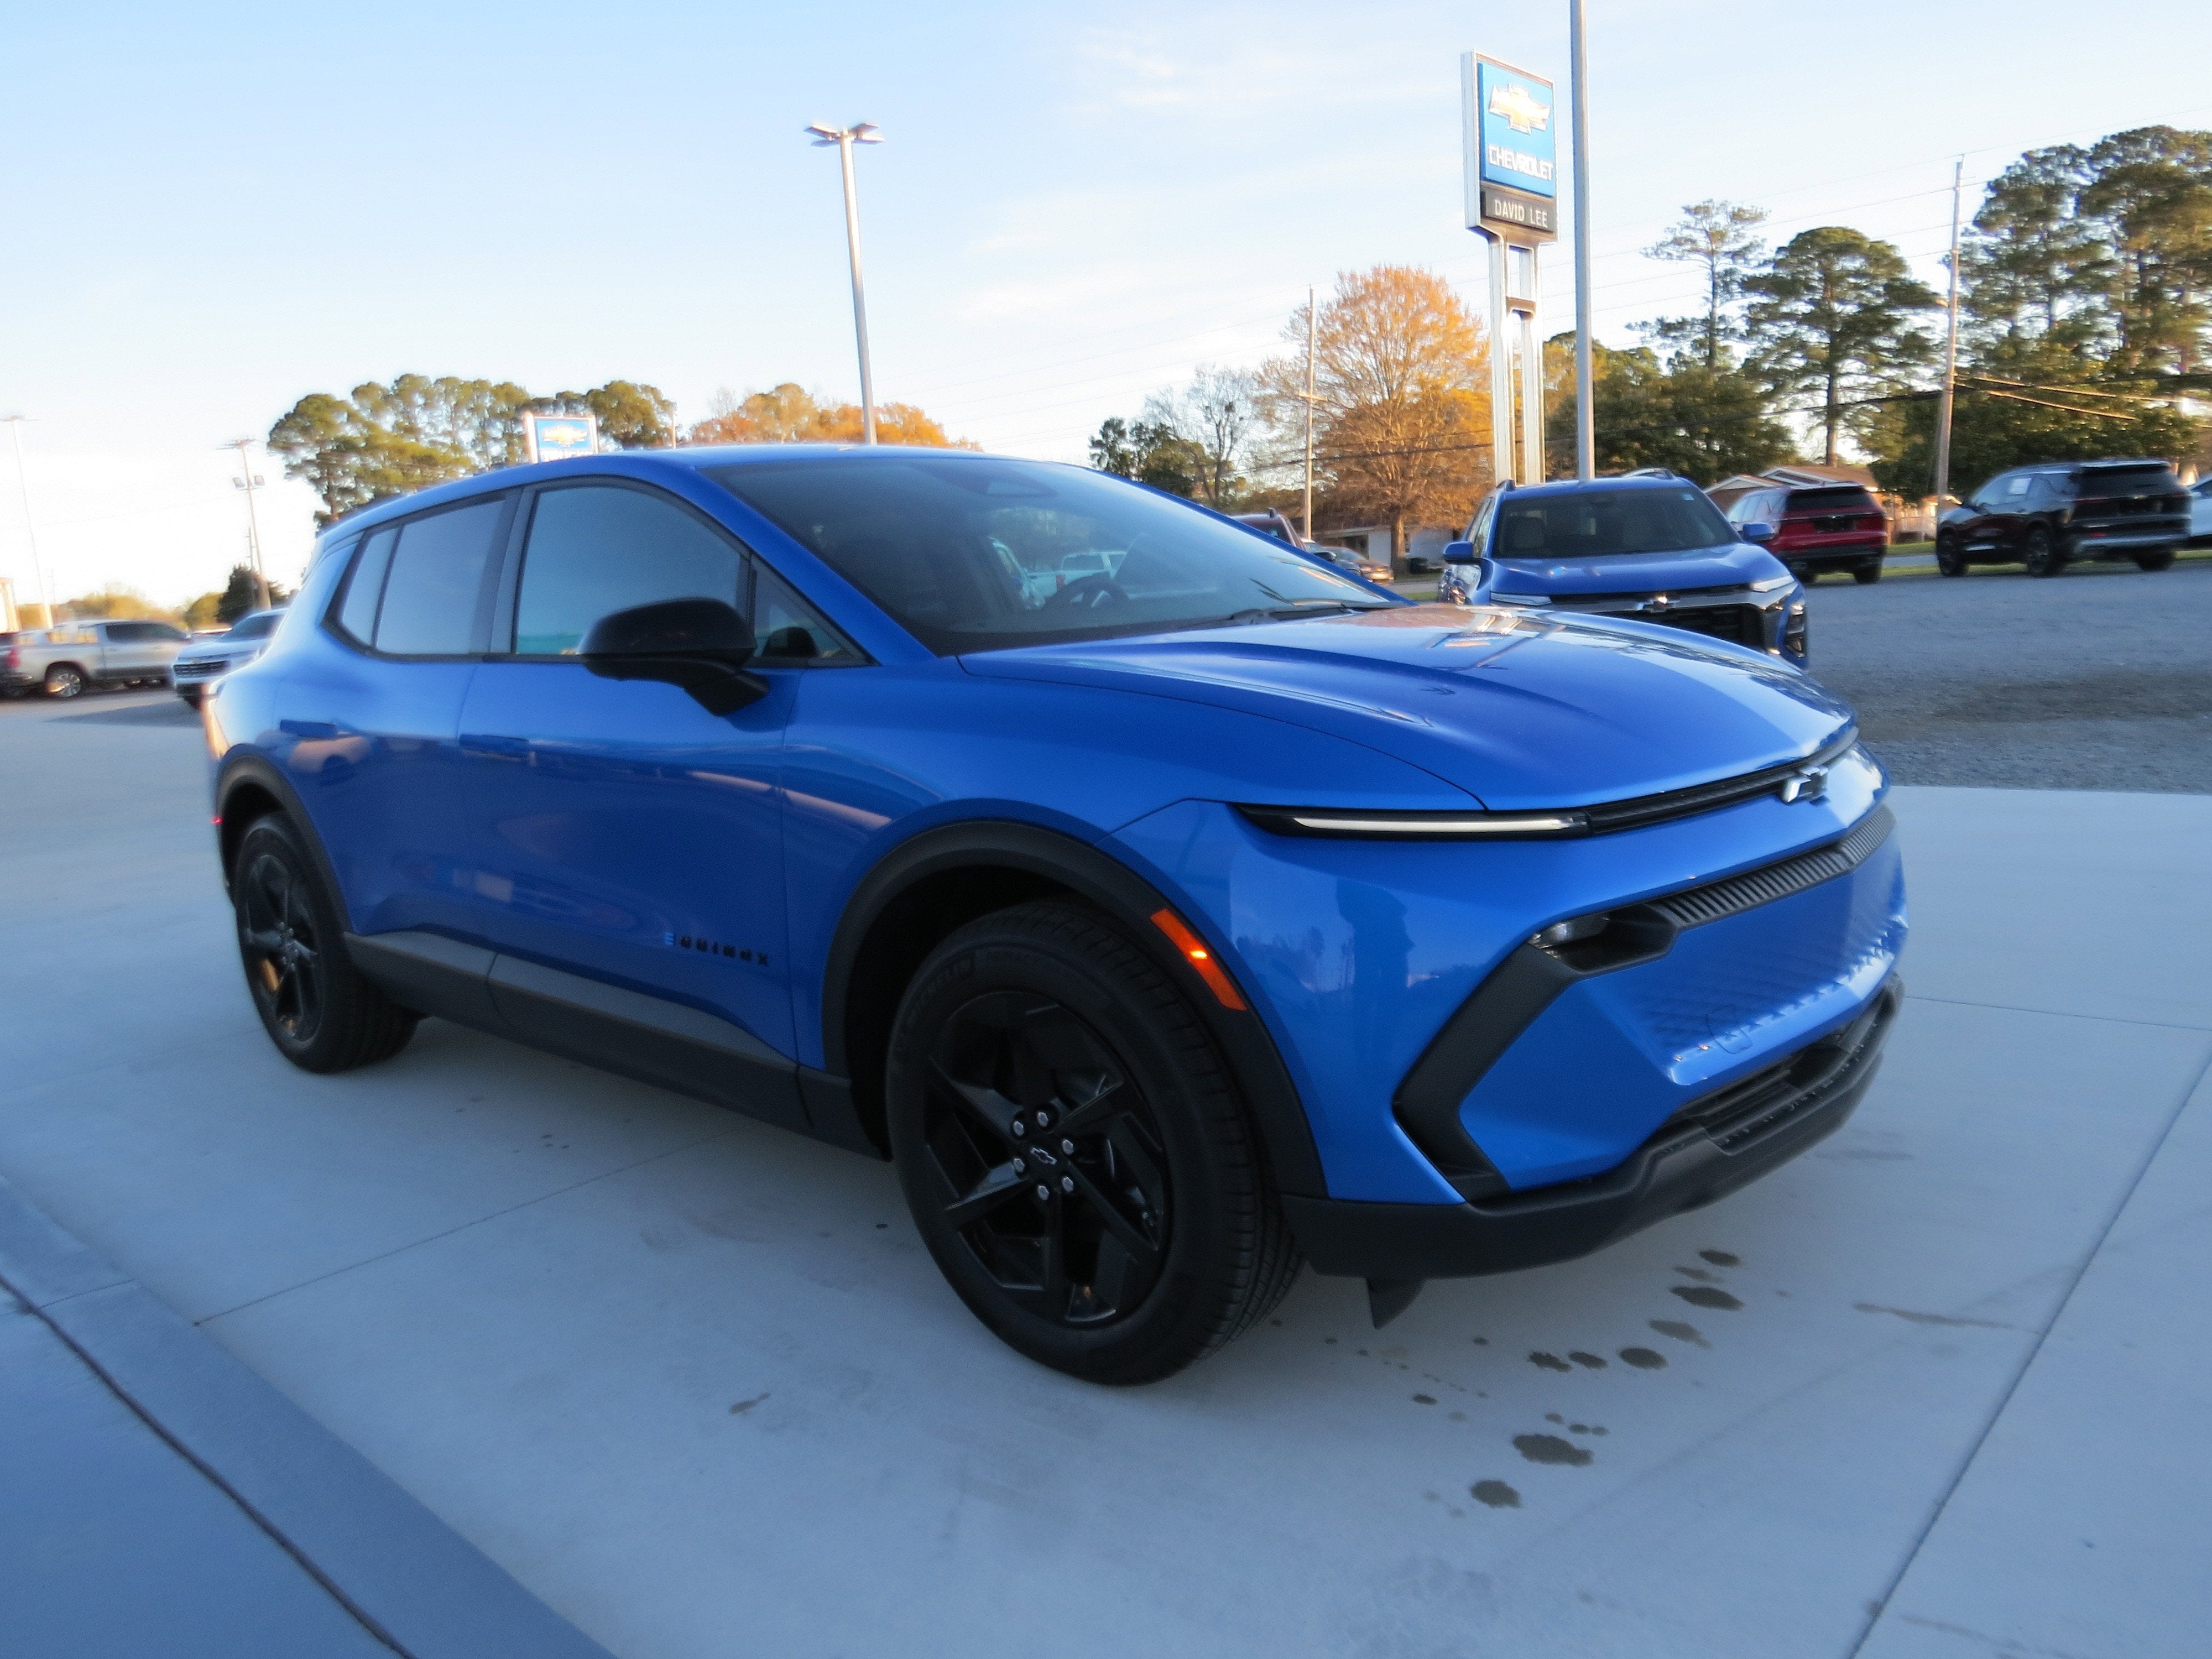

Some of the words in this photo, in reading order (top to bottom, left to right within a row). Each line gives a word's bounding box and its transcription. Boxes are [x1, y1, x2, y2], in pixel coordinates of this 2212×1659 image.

[1488, 144, 1553, 180] CHEVROLET
[1494, 199, 1525, 221] DAVID
[1530, 206, 1548, 227] LEE
